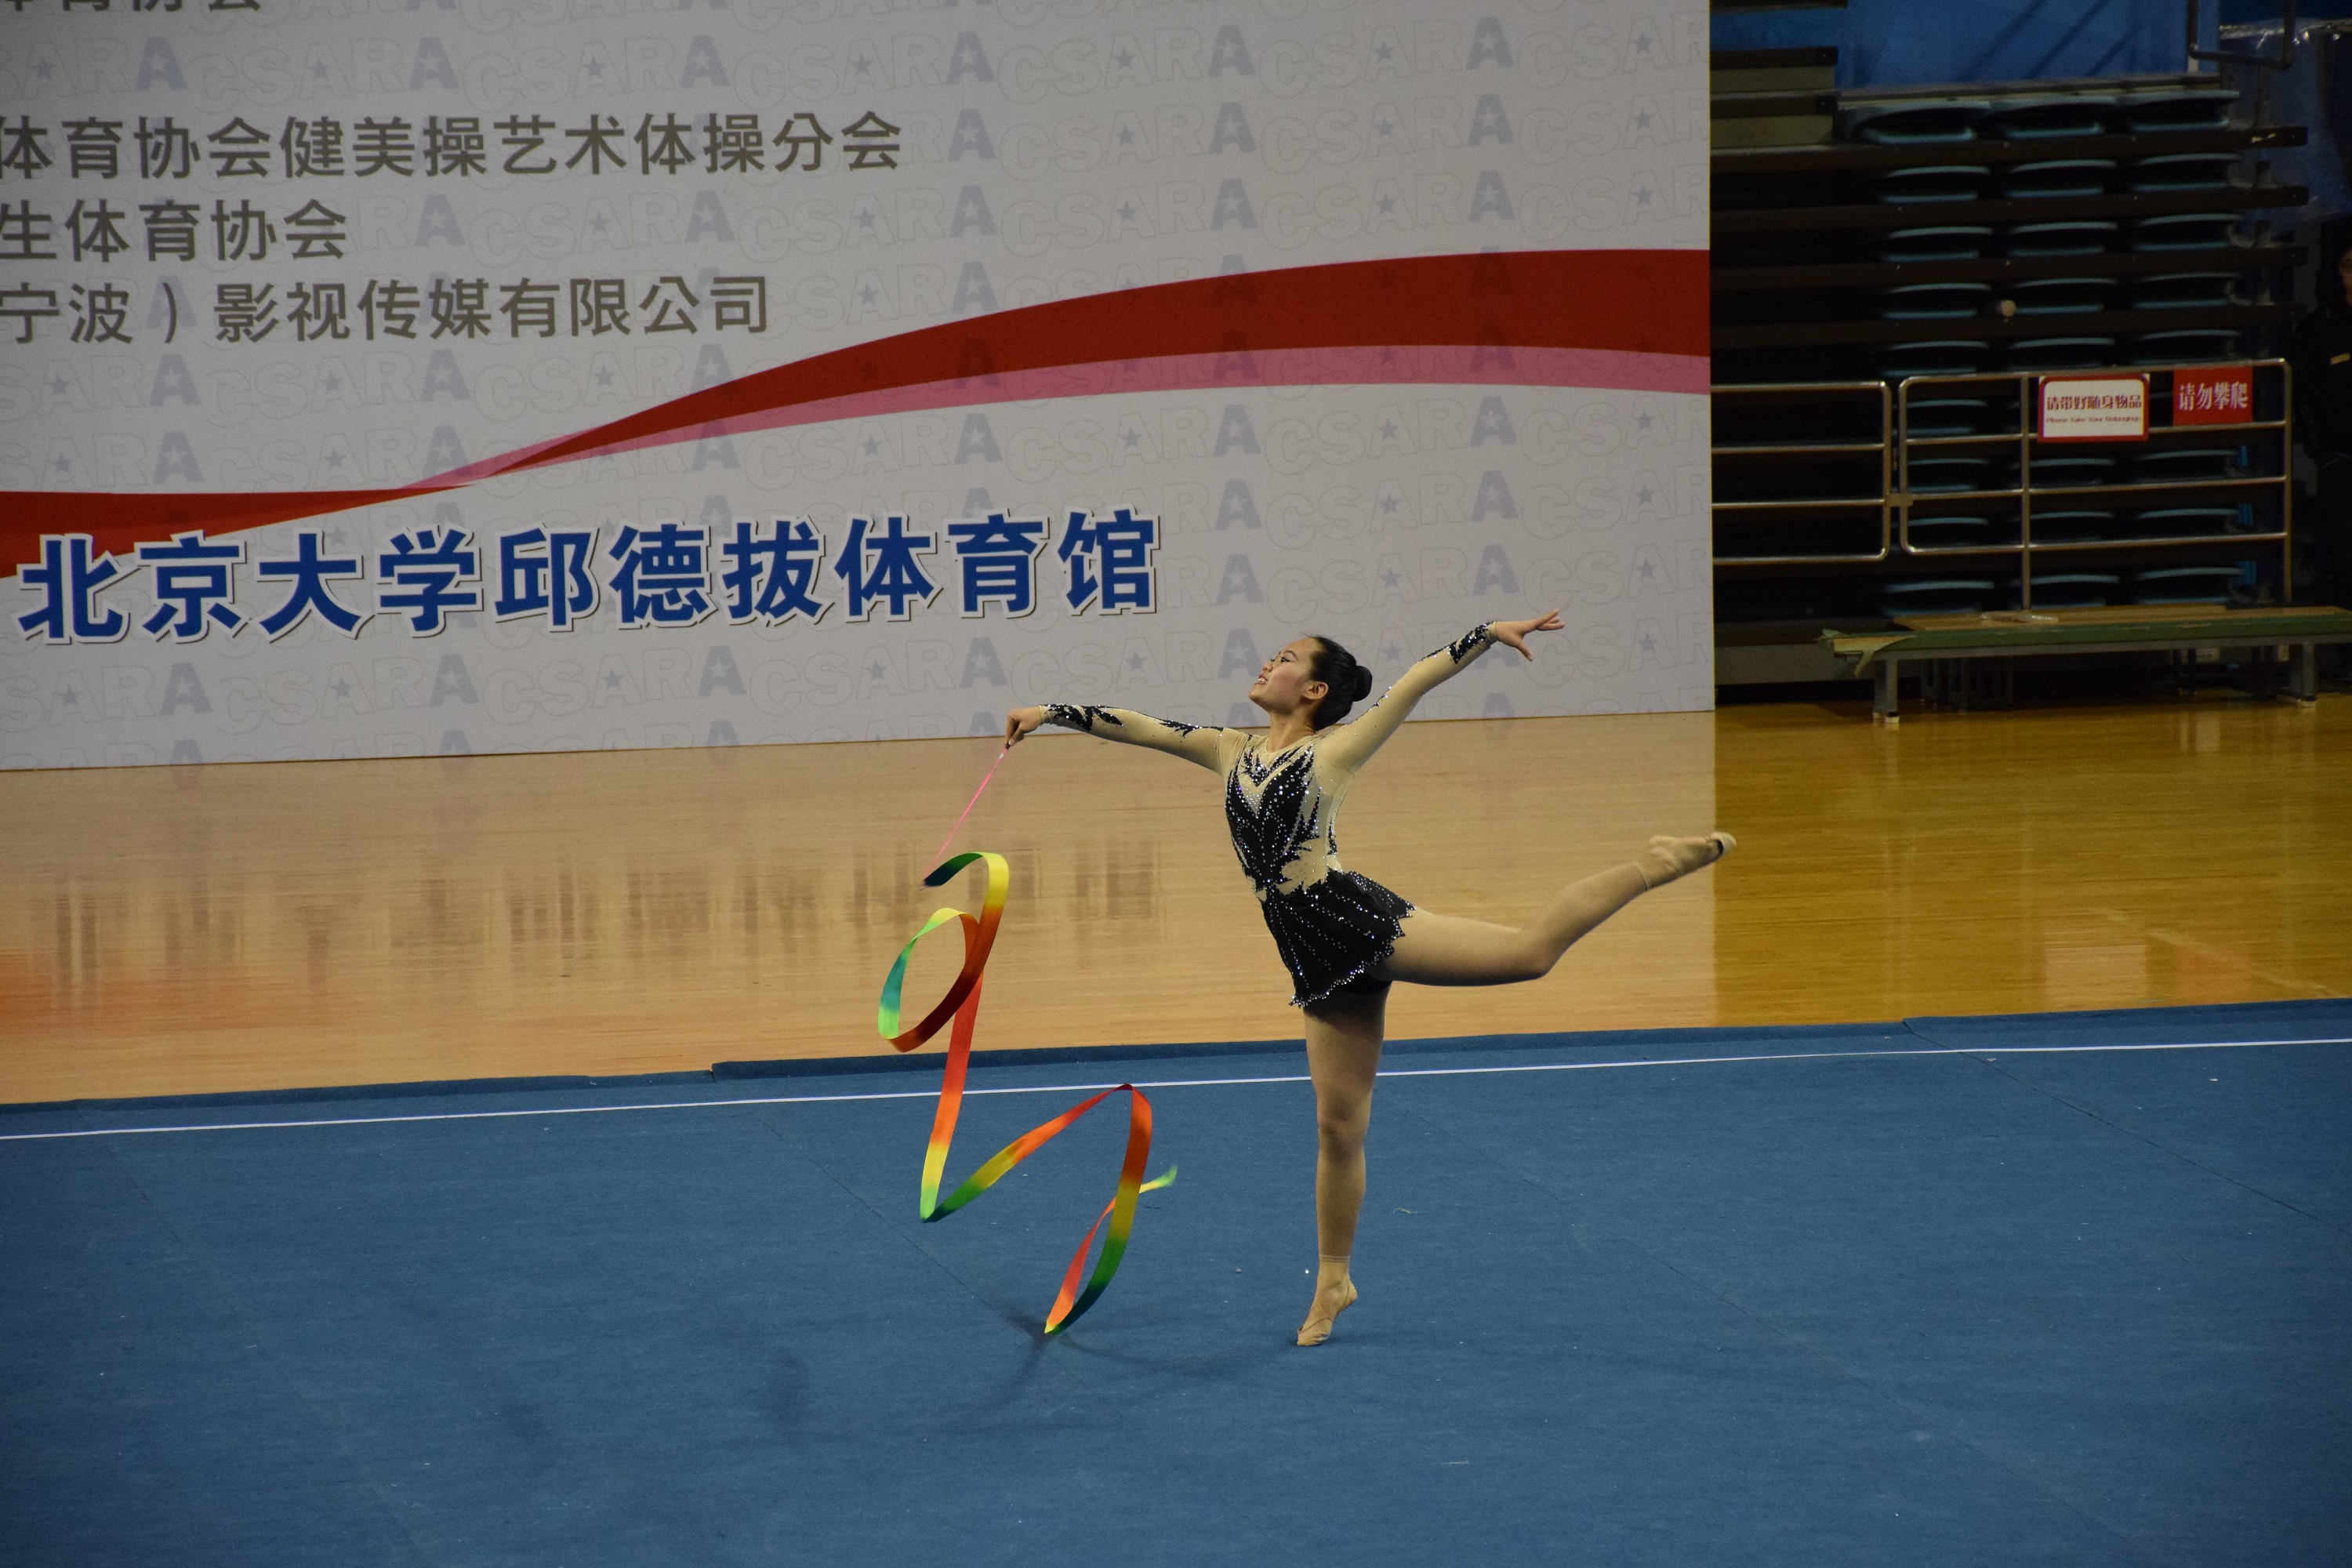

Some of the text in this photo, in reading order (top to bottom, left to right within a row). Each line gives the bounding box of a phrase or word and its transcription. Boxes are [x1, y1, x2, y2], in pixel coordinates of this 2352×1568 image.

[0, 111, 900, 180] 体育协会健美操艺术体操分会
[0, 199, 347, 263] 生体育协会
[2046, 394, 2142, 411] 请带好随身物品
[2178, 381, 2249, 411] 请勿攀爬
[18, 507, 1160, 643] 北京大学邱德拔体育馆
